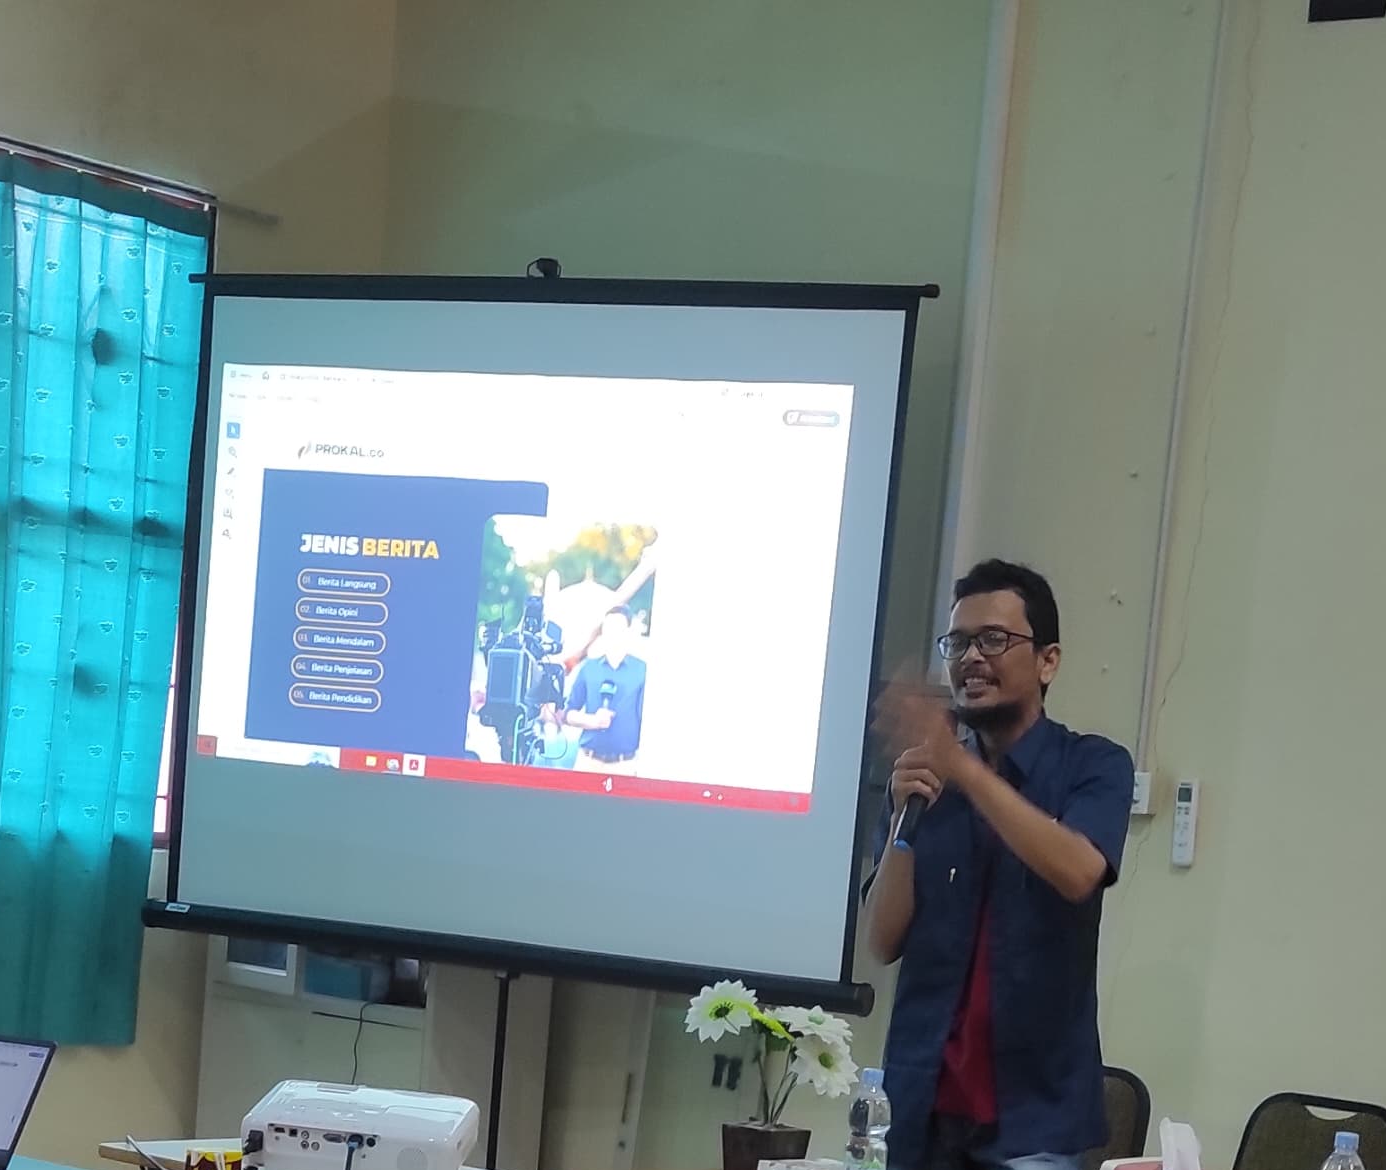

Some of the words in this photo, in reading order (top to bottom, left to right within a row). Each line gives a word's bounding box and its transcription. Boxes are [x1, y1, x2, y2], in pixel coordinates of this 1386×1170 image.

[299, 533, 360, 556] JENIS
[362, 537, 440, 559] BERITA
[317, 576, 340, 587] Berita
[341, 578, 377, 590] Langsung
[315, 605, 337, 615] Berita
[338, 607, 358, 617] Opini
[313, 634, 335, 644] Berita
[336, 636, 375, 647] Mendalam
[311, 663, 333, 673] Berita
[309, 691, 330, 701] Berita
